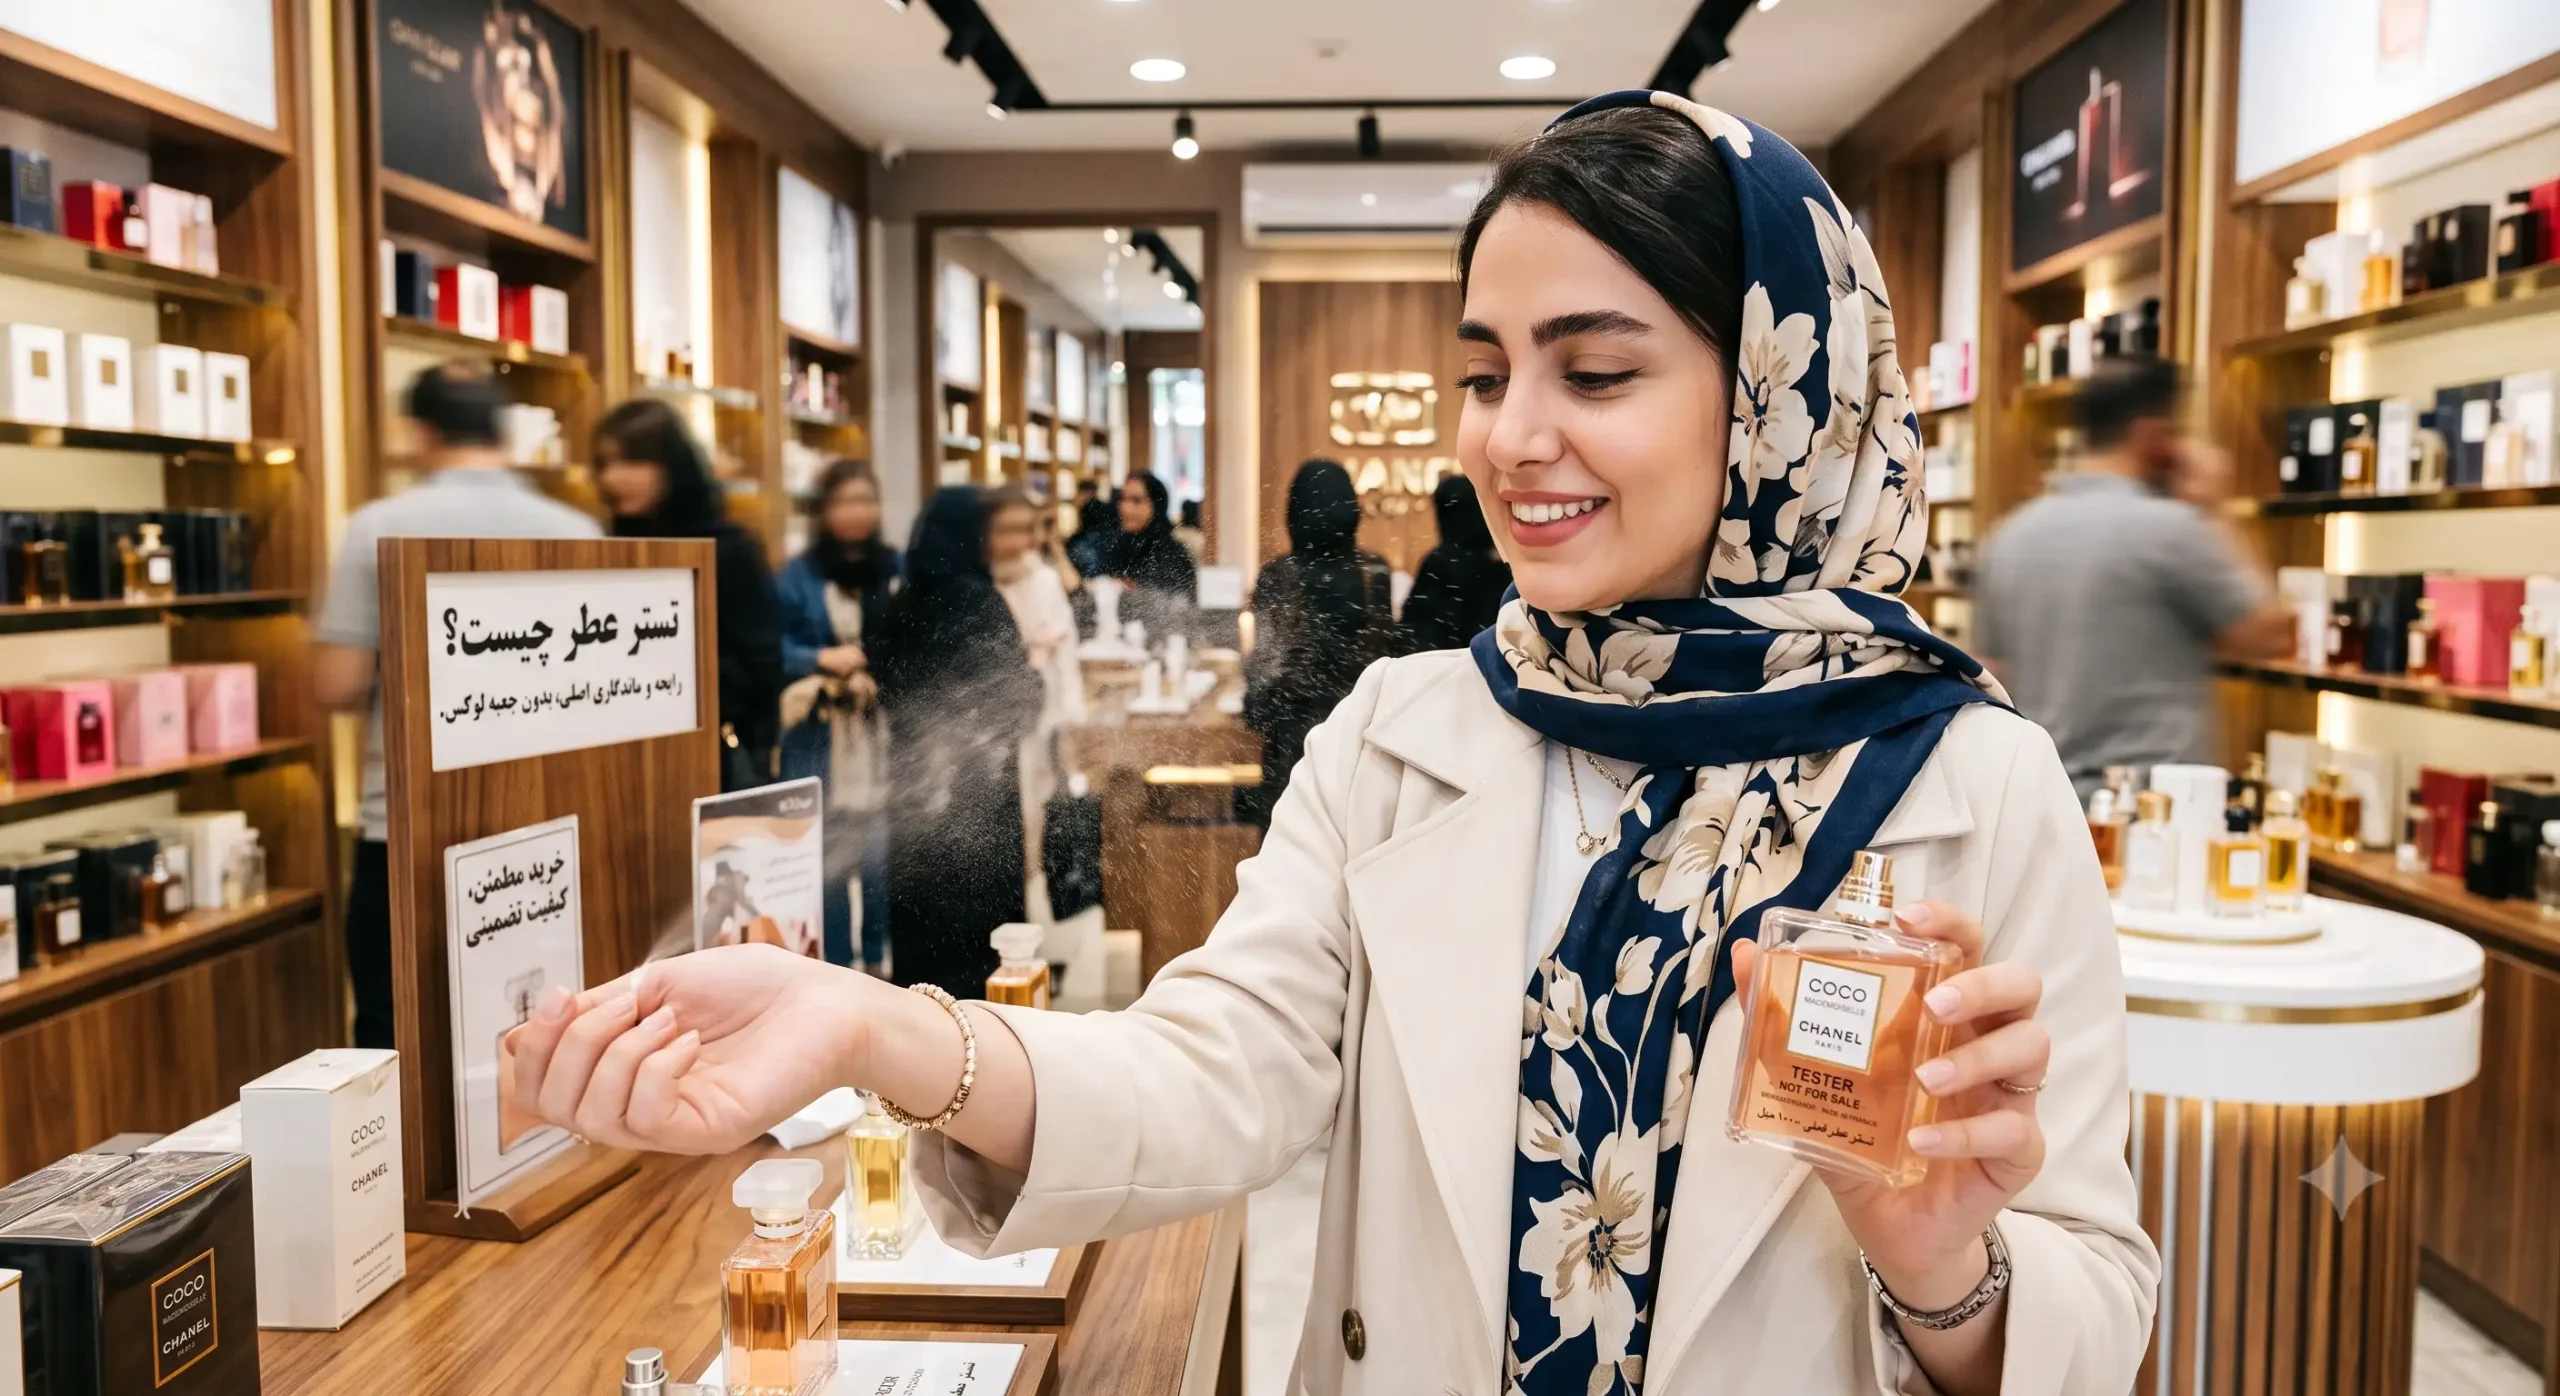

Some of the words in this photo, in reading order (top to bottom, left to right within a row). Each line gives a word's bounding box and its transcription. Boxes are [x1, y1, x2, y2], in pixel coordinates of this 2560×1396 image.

[443, 608, 554, 667] چیست؟
[564, 604, 619, 662] عطر
[627, 601, 680, 657] تستر
[593, 679, 642, 704] ماندگاری
[645, 684, 652, 699] و
[653, 674, 682, 695] رایحه
[489, 697, 518, 717] جعبه
[521, 692, 553, 714] بدون
[530, 850, 565, 883] خرید
[526, 888, 568, 924] کیفیت
[466, 901, 523, 947] تضمینی
[1809, 978, 1867, 1003] COCO
[1799, 1020, 1862, 1045] CHANEL
[1791, 1065, 1854, 1093] TESTER
[1779, 1080, 1803, 1094] NOT
[1804, 1087, 1828, 1101] FOR
[1830, 1094, 1861, 1110] SALE
[351, 1115, 386, 1145] COCO
[351, 1162, 389, 1192] CHANEL
[163, 1274, 205, 1310] COCO
[162, 1316, 211, 1355] CHANEL
